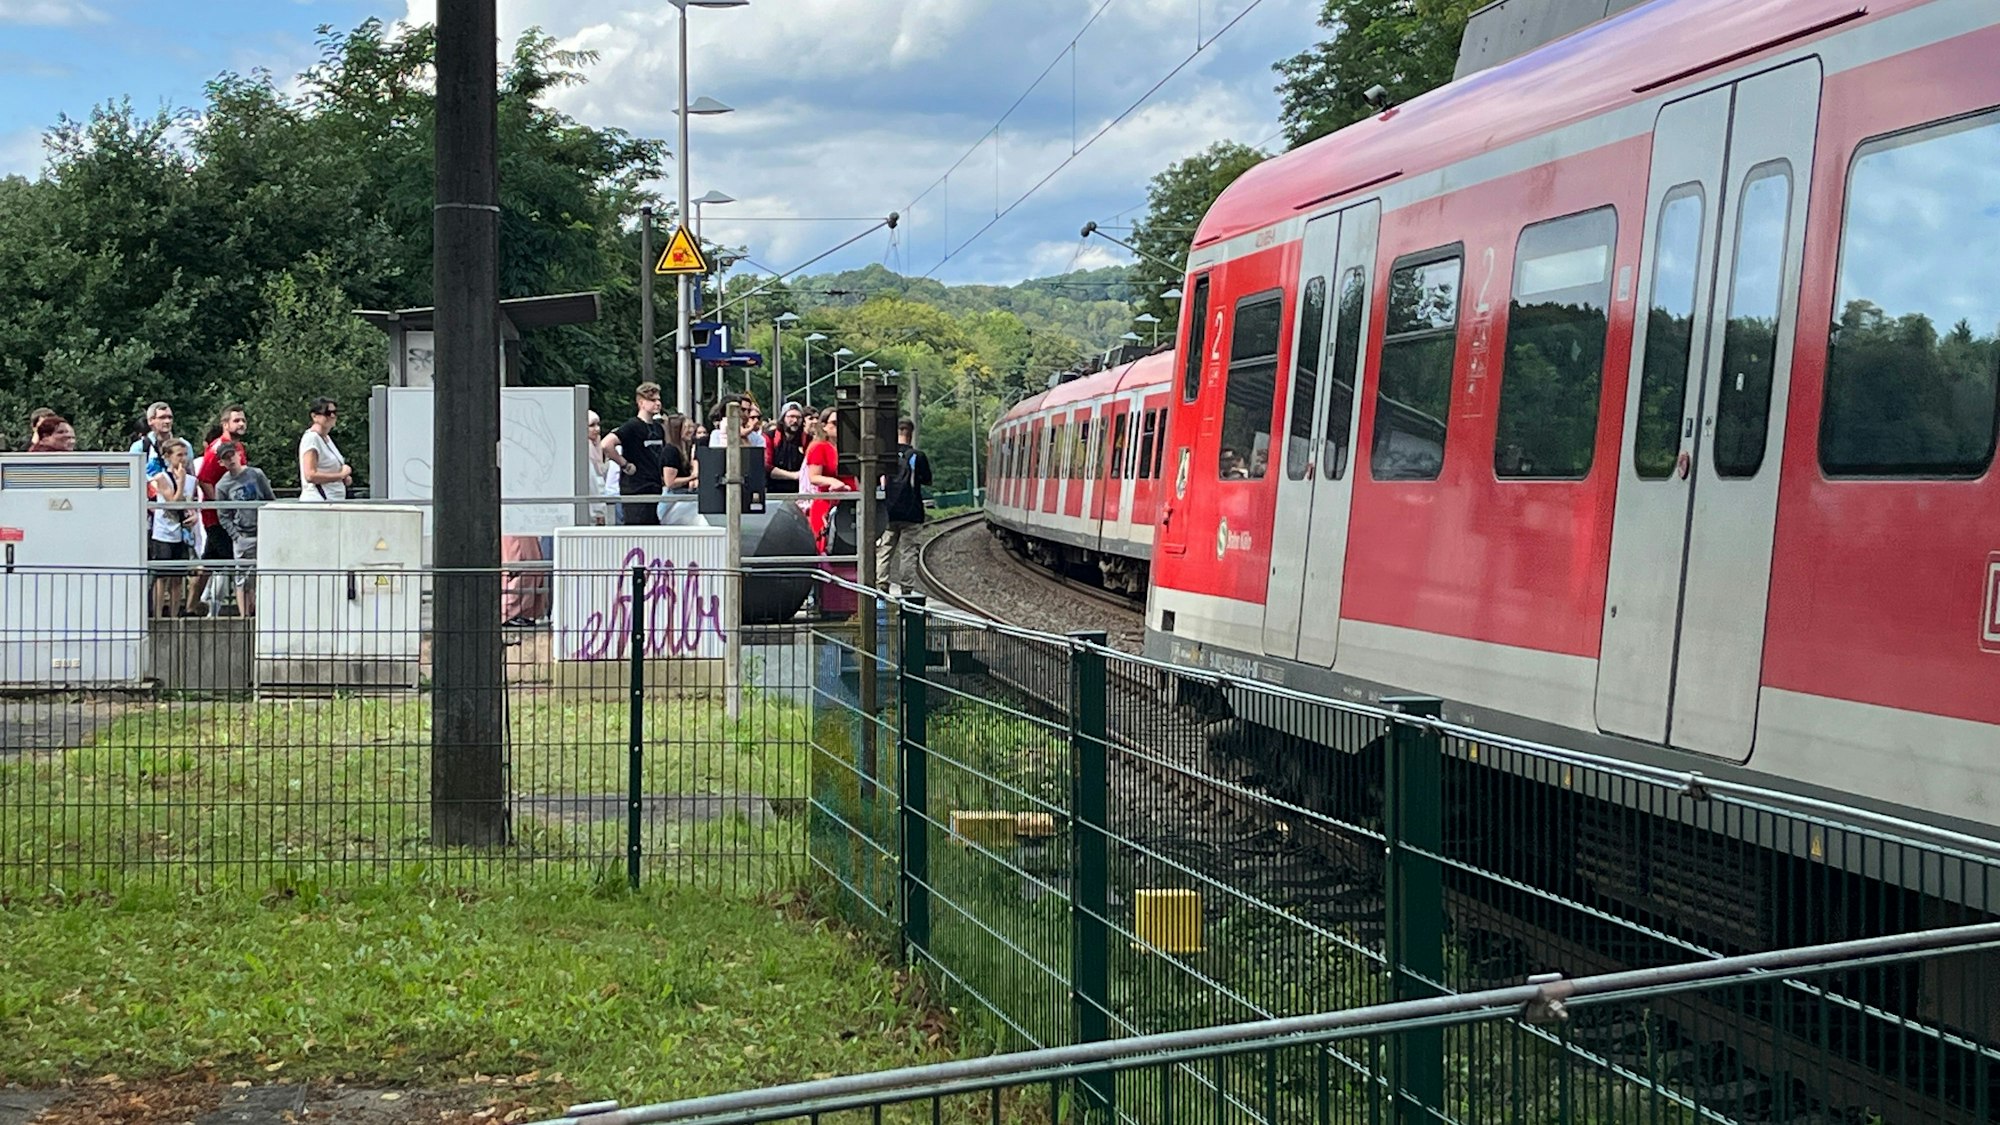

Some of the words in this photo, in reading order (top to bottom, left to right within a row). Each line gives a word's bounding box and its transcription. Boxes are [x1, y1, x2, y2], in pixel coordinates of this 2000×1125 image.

[1476, 247, 1495, 313] 2
[714, 325, 727, 353] 1
[1212, 311, 1223, 359] 2
